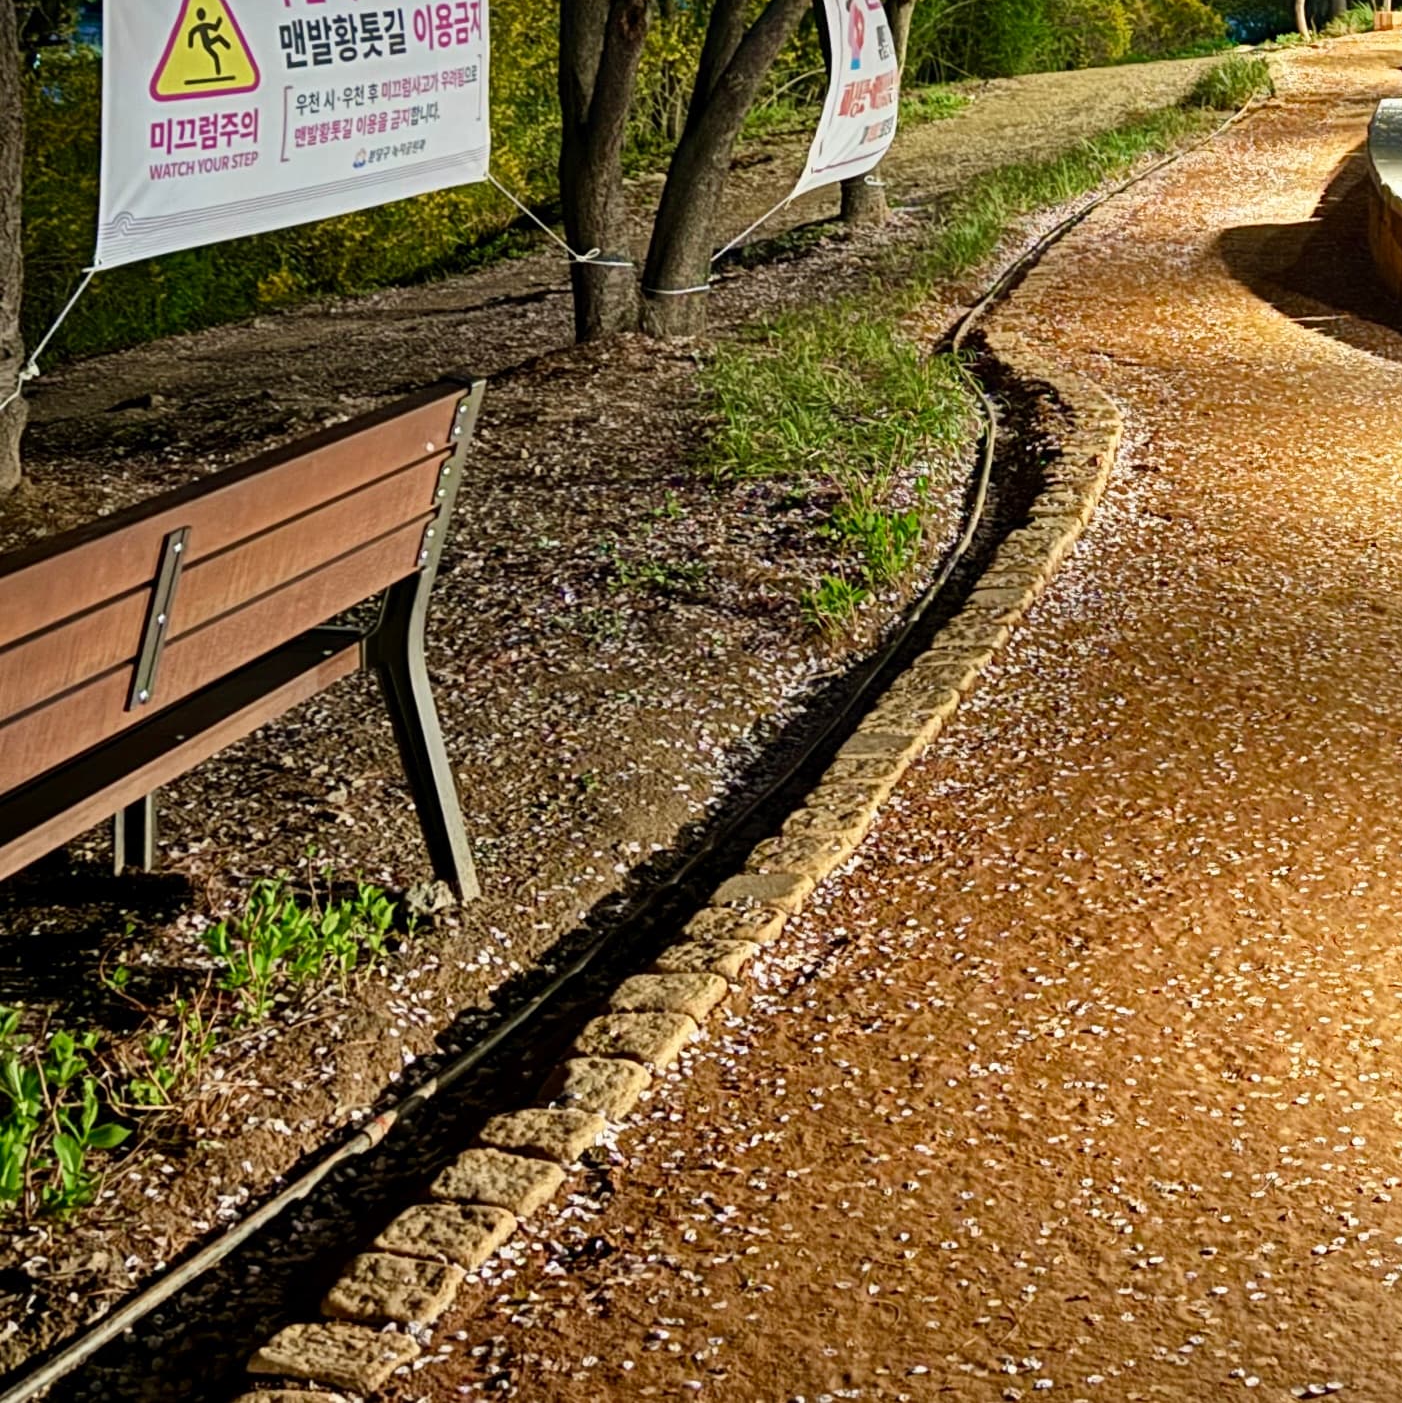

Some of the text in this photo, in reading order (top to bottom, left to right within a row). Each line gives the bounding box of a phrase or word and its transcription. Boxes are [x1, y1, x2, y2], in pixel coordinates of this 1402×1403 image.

[279, 8, 407, 70] 맨발황톳길
[295, 91, 320, 116] 우천
[367, 83, 379, 104] 후
[381, 72, 439, 101] 미끄럼사고가
[150, 107, 259, 155] 미끄럼주의
[356, 111, 389, 136] 이용을
[149, 151, 259, 180] WATCH YOUR STEP
